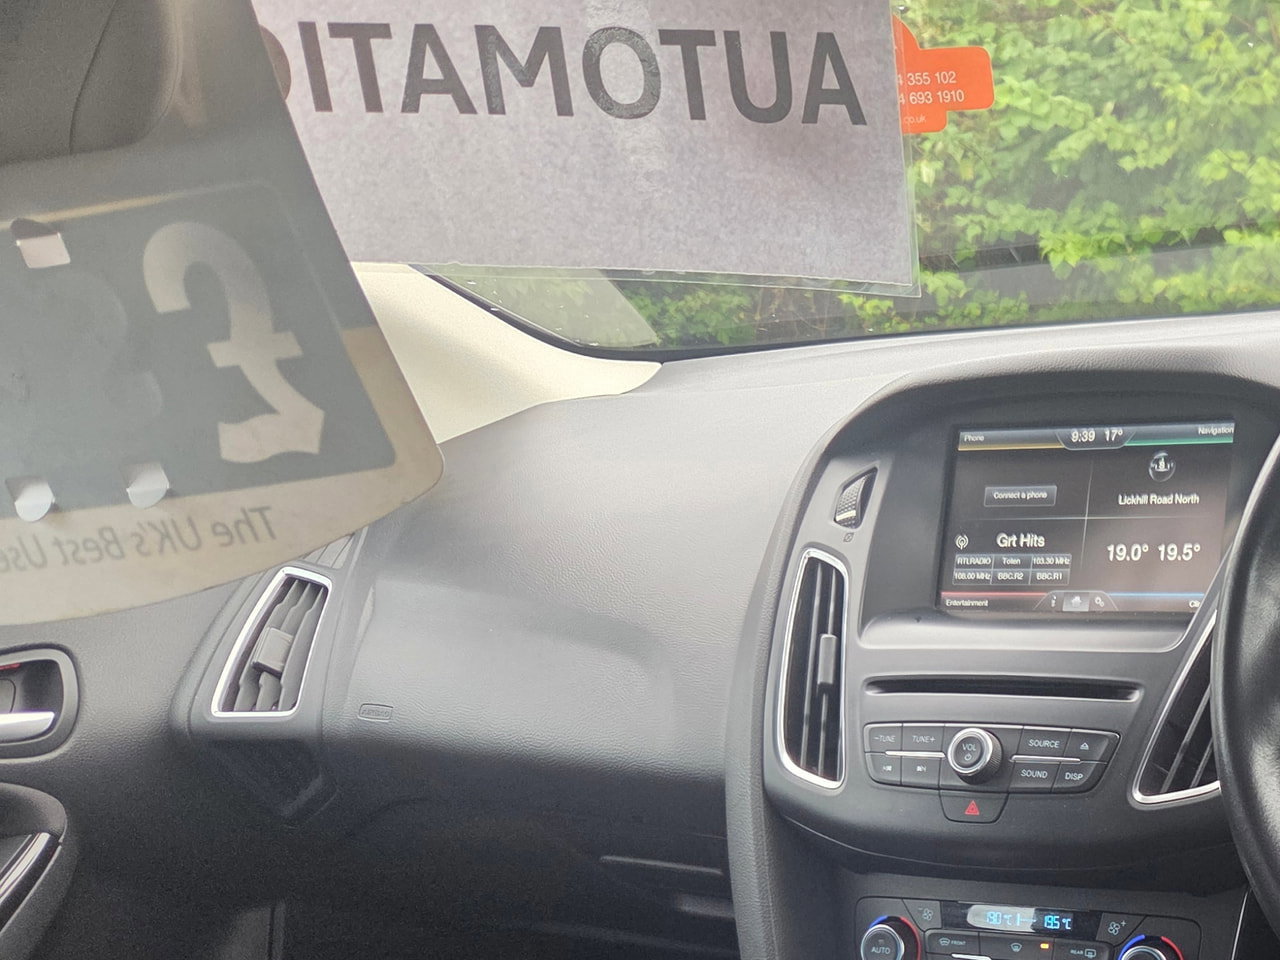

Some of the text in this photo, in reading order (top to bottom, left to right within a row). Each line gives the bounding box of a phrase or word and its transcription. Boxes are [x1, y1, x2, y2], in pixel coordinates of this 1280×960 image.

[907, 72, 931, 86] 355
[934, 71, 957, 84] 102
[909, 91, 933, 105] 693
[936, 89, 965, 103] 1910
[1198, 425, 1235, 436] Navigation
[963, 434, 985, 442] Phone
[1071, 429, 1096, 443] 9:39
[993, 491, 1021, 500] Connect
[1027, 491, 1048, 501] phone
[1150, 494, 1174, 505] Road
[1175, 493, 1201, 504] North
[996, 532, 1046, 549] Grt Hits
[945, 599, 989, 607] Entertainment
[962, 743, 977, 751] VOL
[1028, 738, 1060, 748] SOURCE
[1021, 769, 1048, 780] SOUND
[1065, 771, 1083, 781] DISP
[871, 946, 891, 955] AUTO
